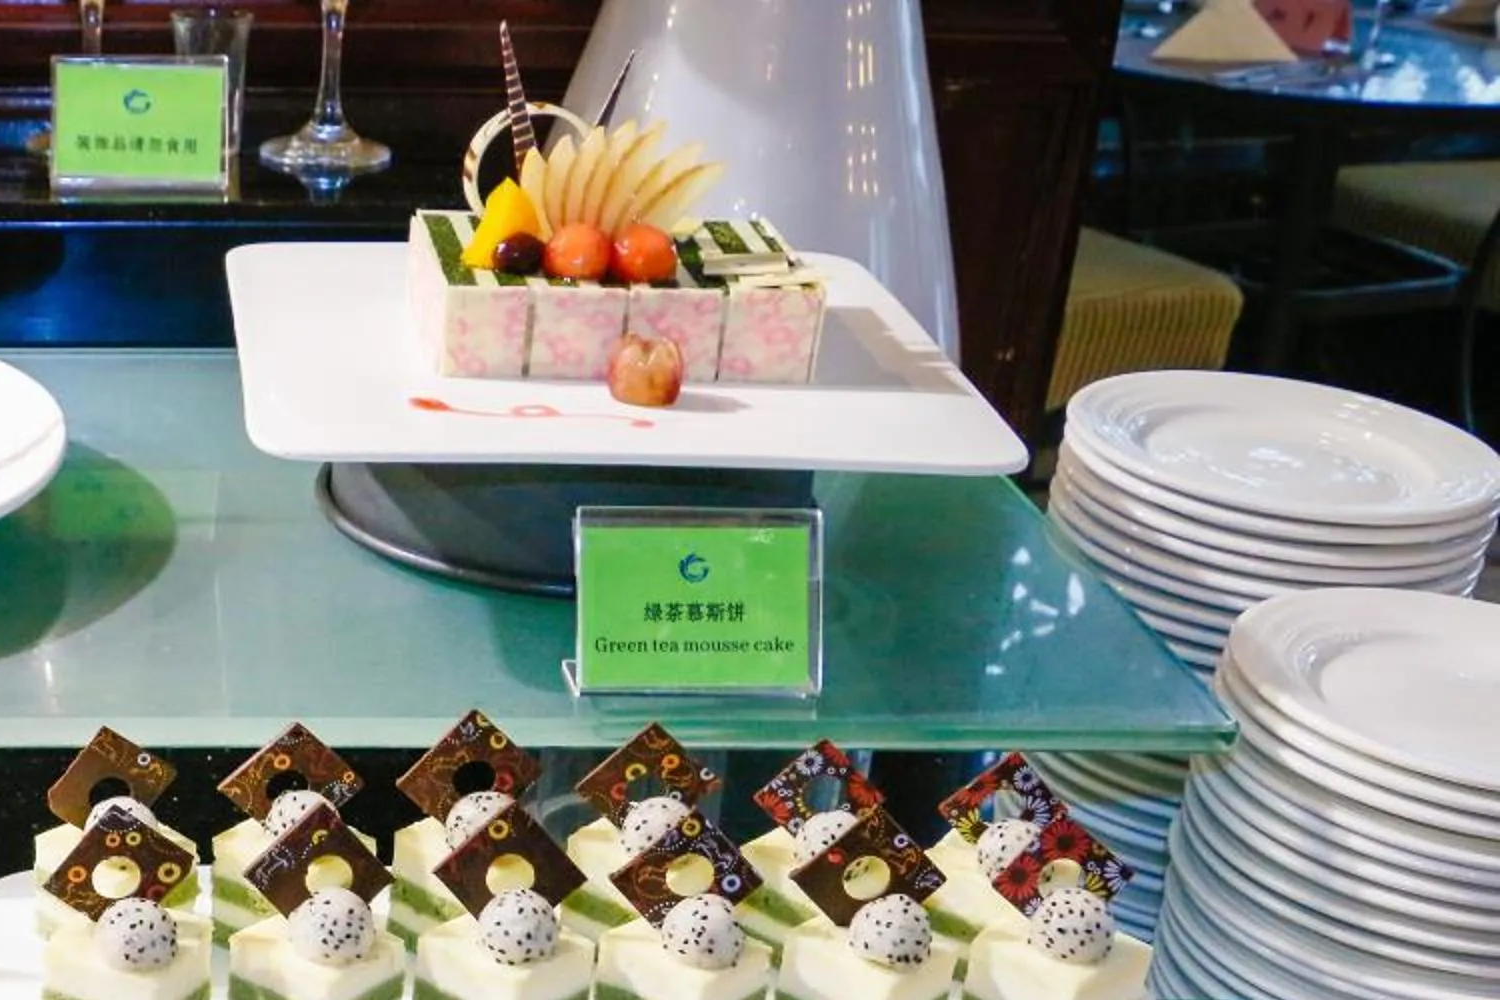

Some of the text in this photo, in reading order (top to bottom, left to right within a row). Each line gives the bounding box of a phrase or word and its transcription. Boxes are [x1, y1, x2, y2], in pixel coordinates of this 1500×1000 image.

[643, 601, 747, 623] 绿茶慕斯饼
[595, 637, 795, 653] Green tea mousse cake
